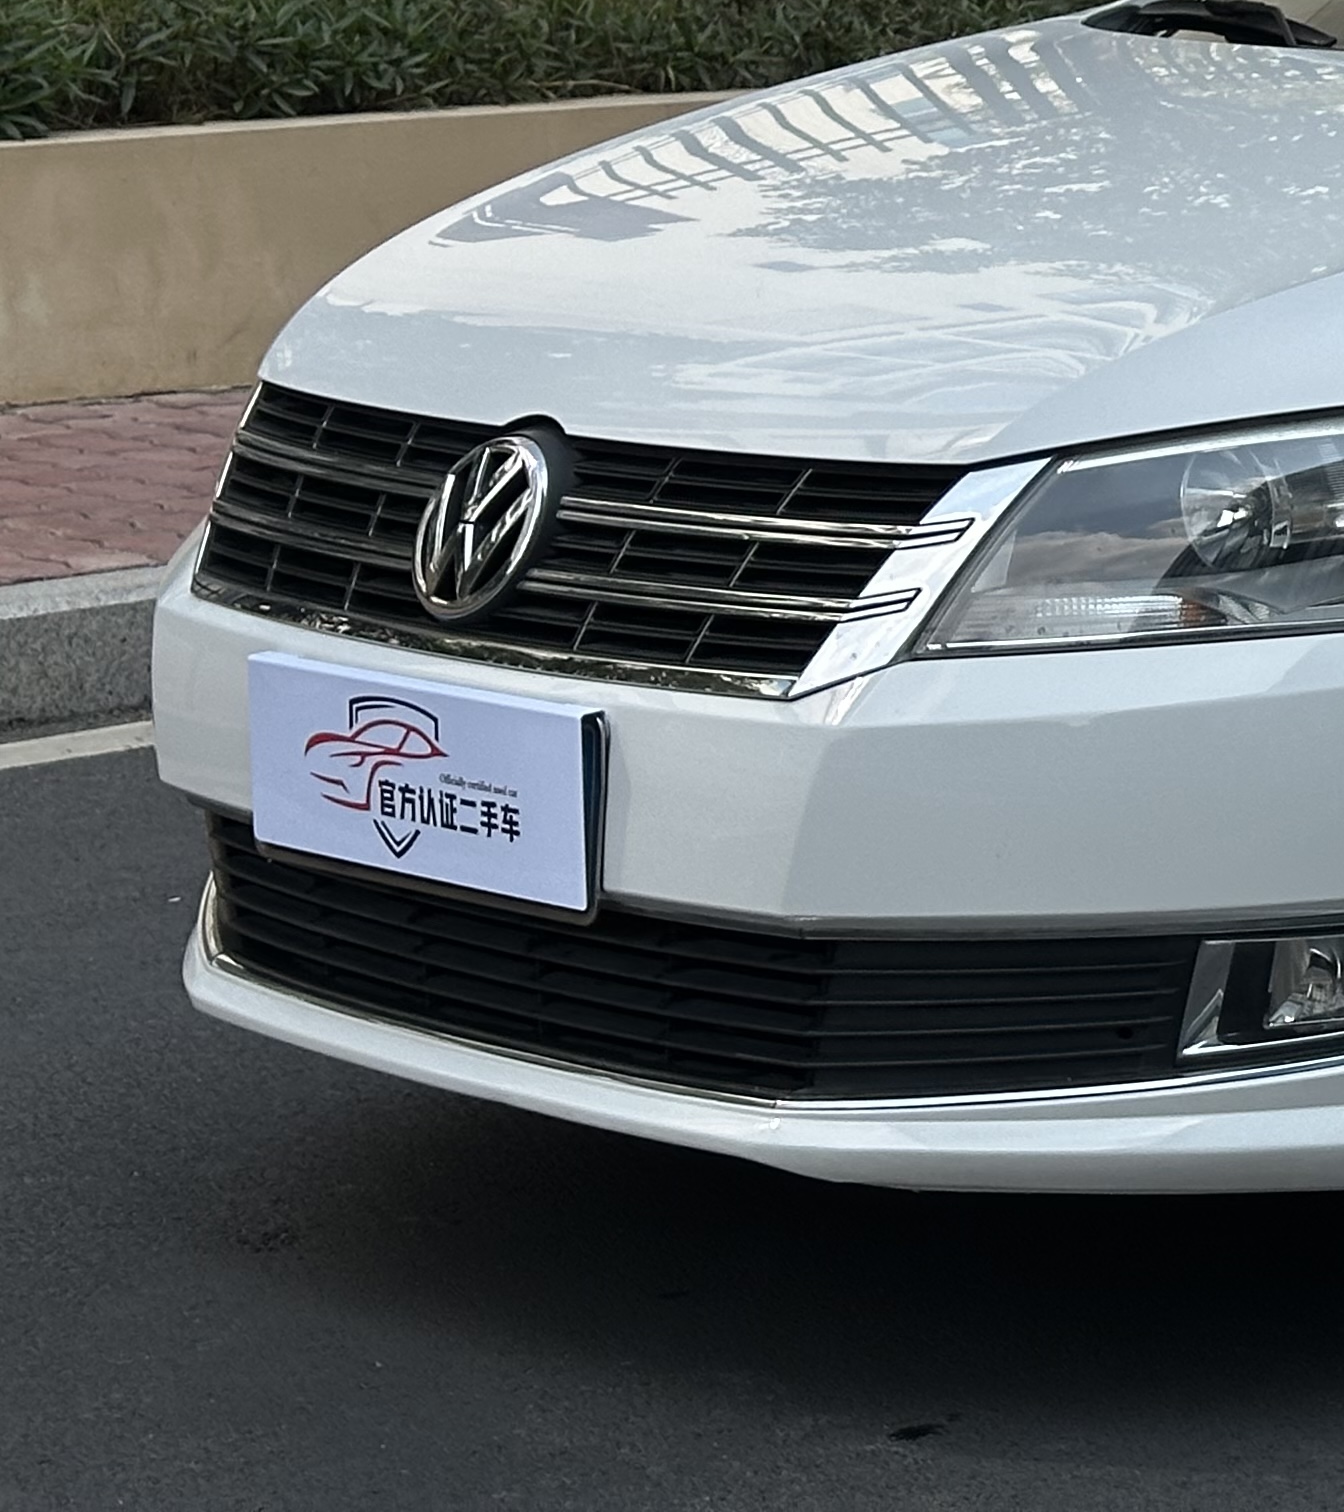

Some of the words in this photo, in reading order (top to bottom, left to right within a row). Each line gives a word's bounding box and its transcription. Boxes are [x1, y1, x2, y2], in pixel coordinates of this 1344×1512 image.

[378, 779, 521, 843] 官方认证二手车
